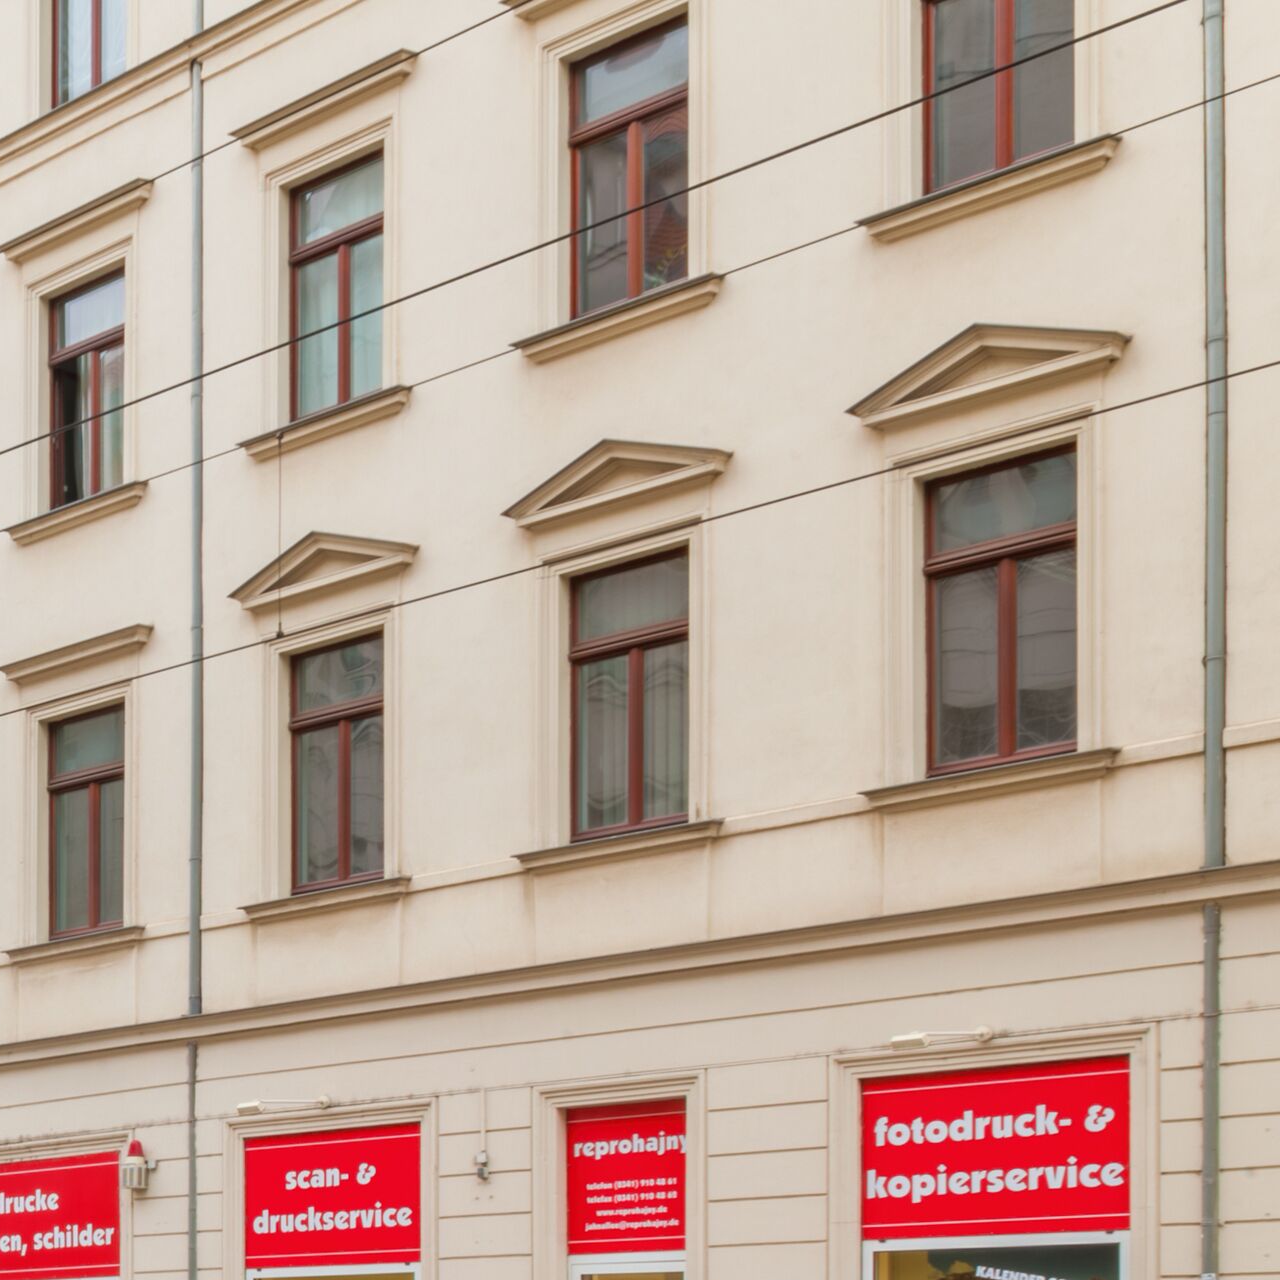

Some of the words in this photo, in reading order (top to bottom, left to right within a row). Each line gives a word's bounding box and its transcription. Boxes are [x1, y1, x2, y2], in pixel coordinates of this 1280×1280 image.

[874, 1104, 1072, 1147] fotodruck-
[1084, 1104, 1115, 1133] &
[573, 1130, 686, 1161] reprohajny
[285, 1168, 350, 1191] scan-
[356, 1162, 377, 1185] &
[866, 1155, 1125, 1204] kopierservice
[253, 1201, 413, 1235] druckservice
[33, 1223, 115, 1251] schilder
